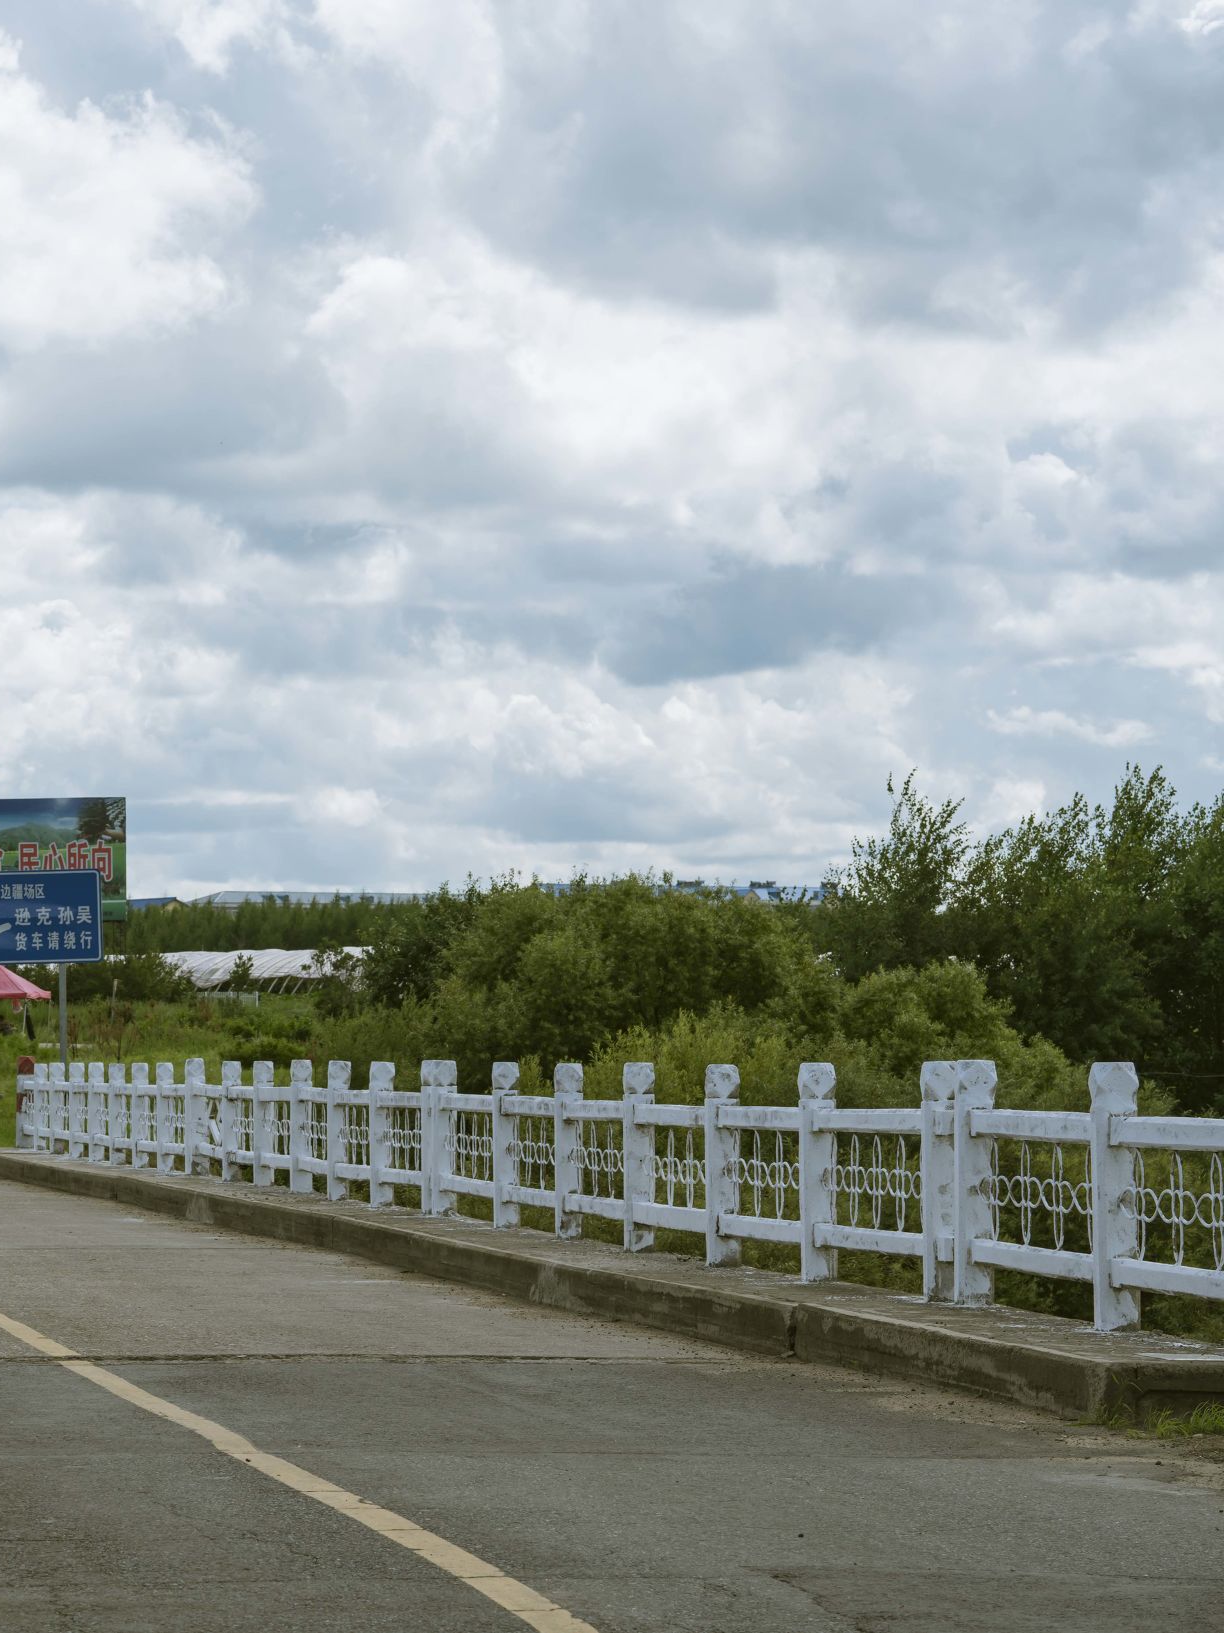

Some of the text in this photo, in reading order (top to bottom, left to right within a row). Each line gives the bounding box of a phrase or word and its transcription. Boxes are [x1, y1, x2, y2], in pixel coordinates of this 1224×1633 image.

[18, 840, 114, 881] 民心所向
[15, 930, 93, 951] 货车请绕行
